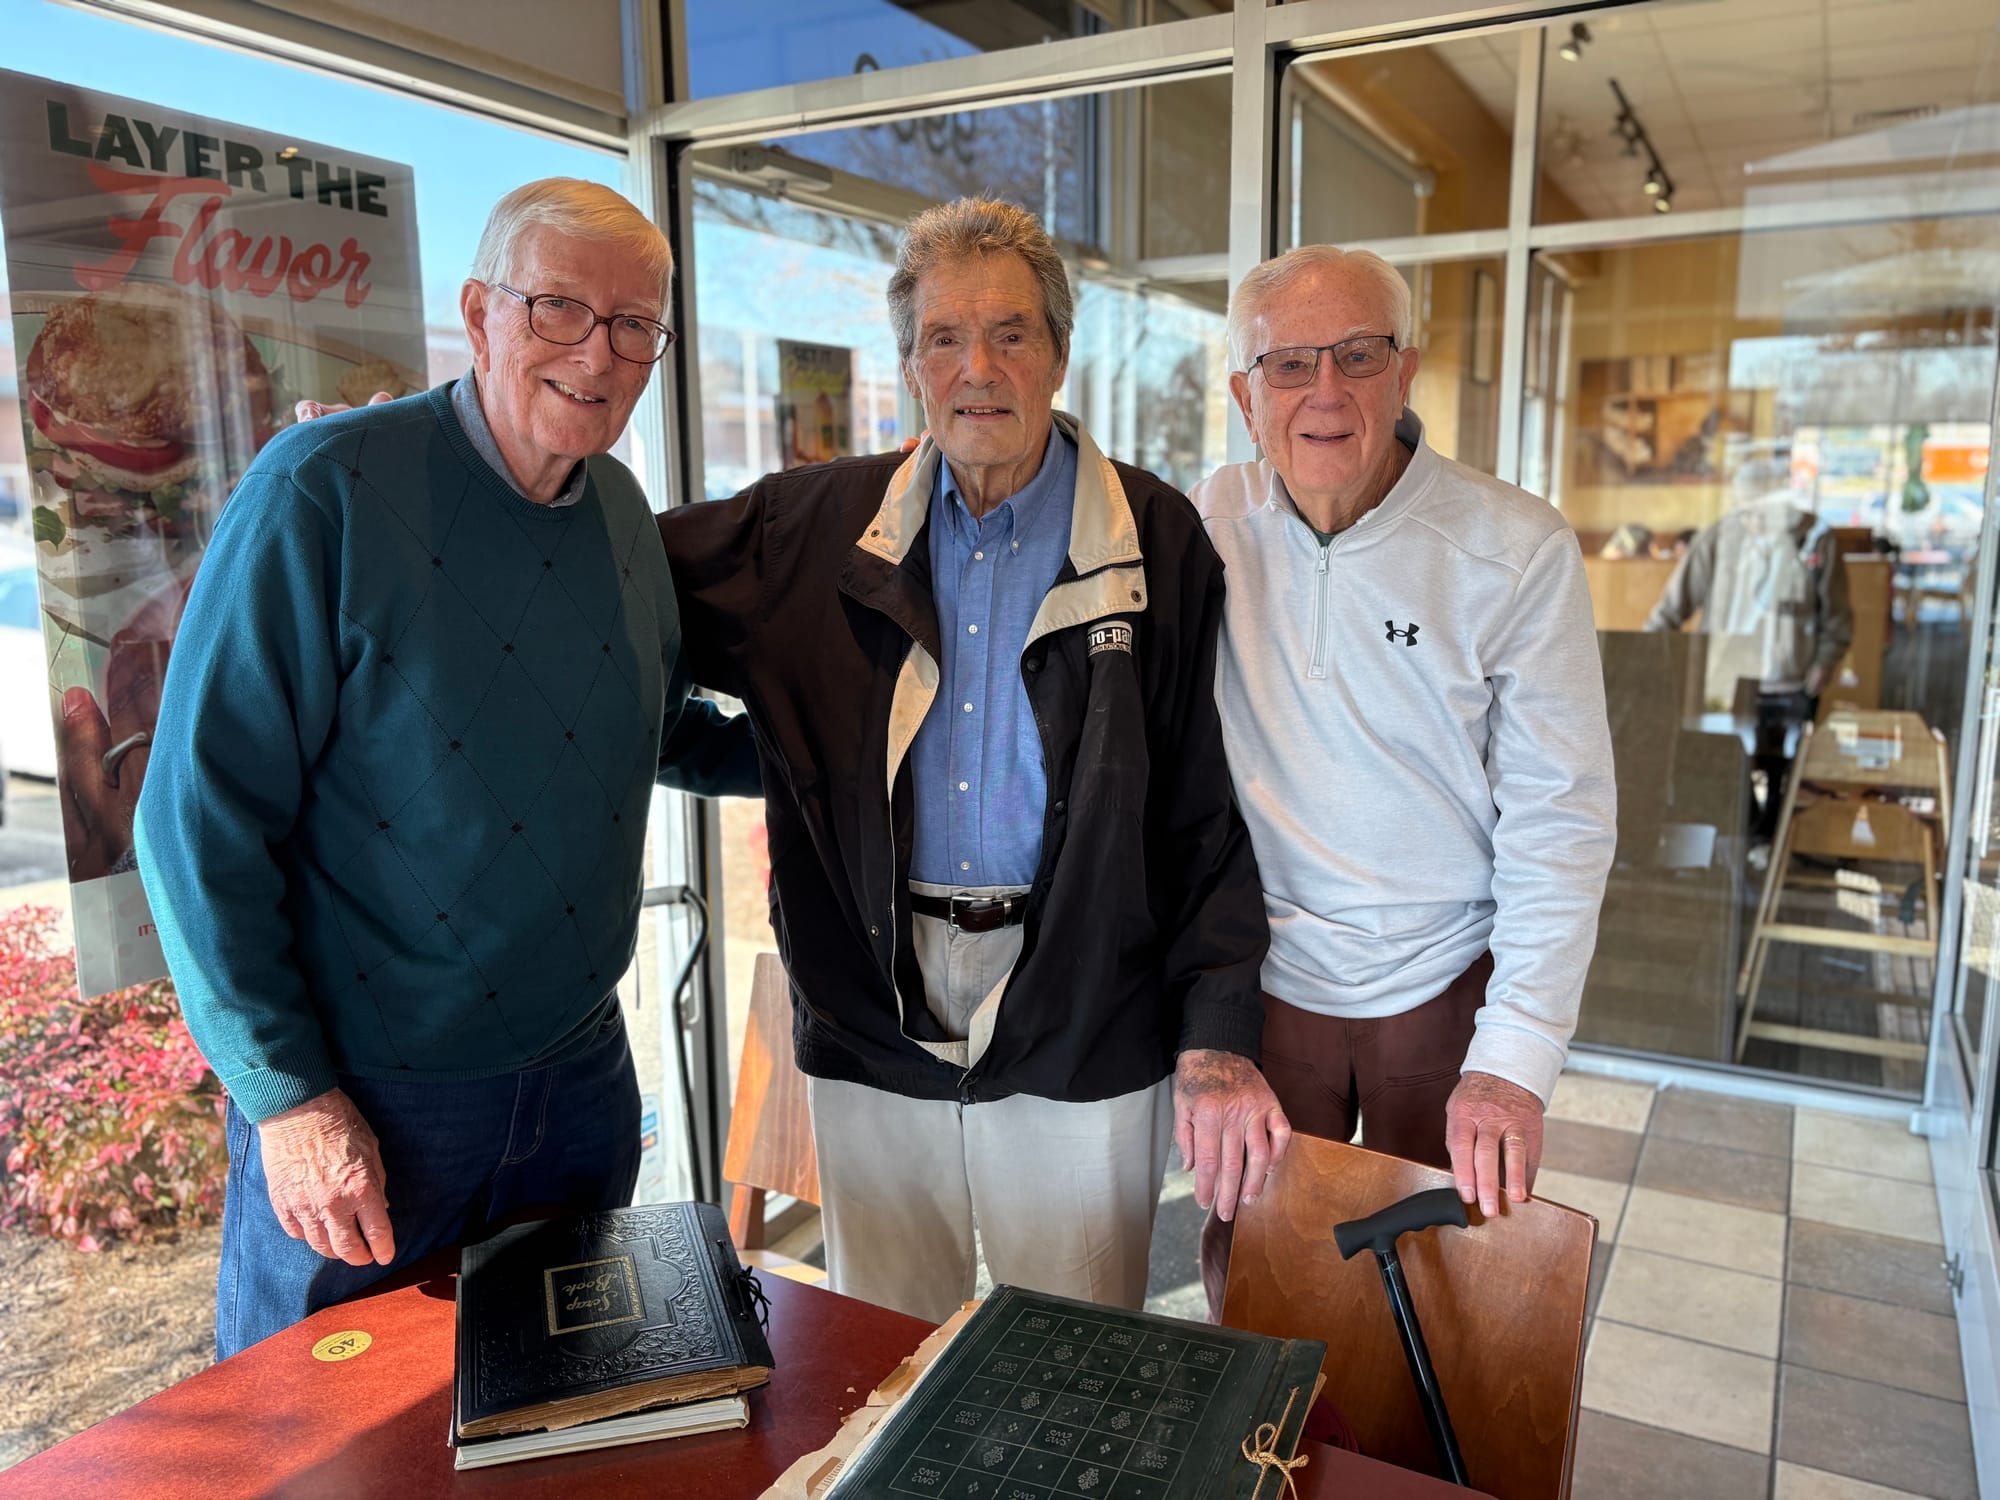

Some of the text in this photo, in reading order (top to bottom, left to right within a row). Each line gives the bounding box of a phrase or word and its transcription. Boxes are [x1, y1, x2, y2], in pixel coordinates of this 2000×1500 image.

[46, 100, 388, 218] LAYER THE
[72, 160, 373, 310] Flavor
[560, 1271, 619, 1297] Book
[565, 1290, 619, 1313] Scrap
[327, 1337, 355, 1355] 40
